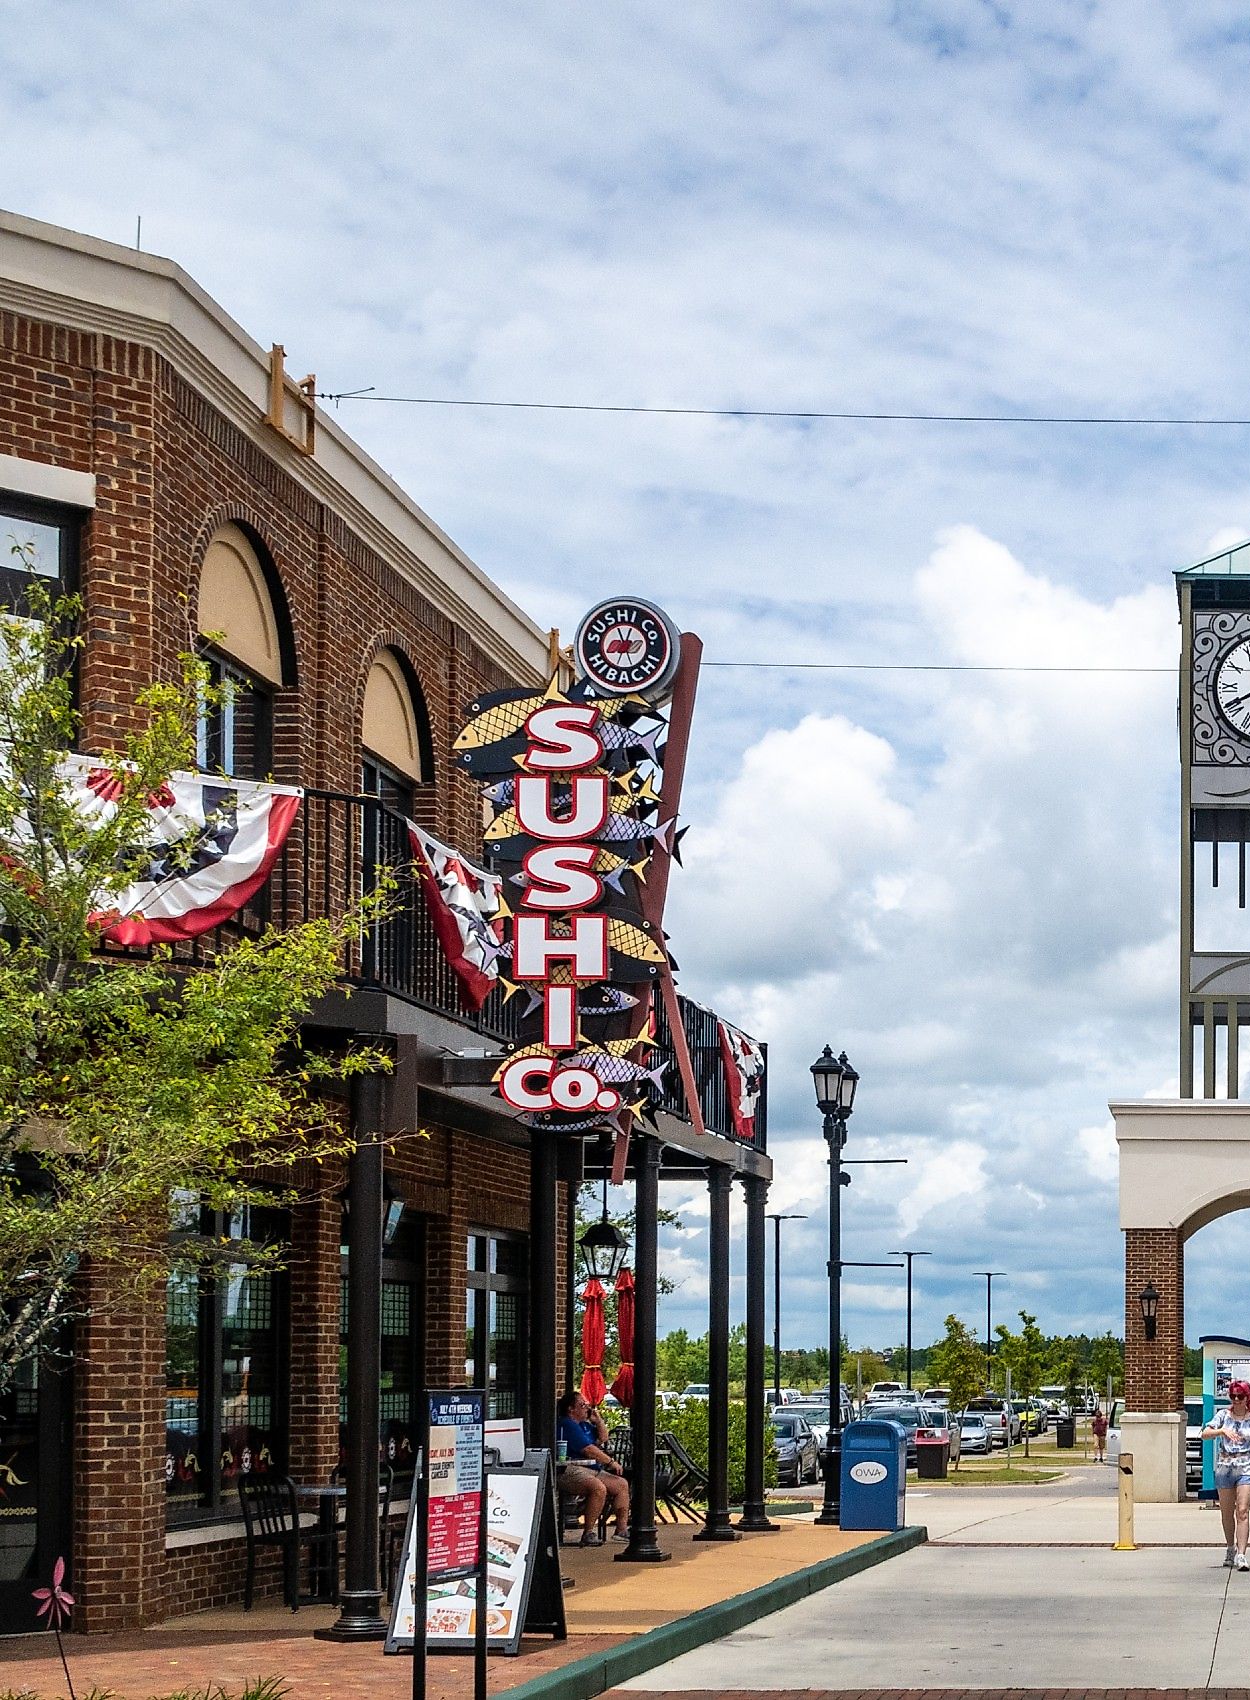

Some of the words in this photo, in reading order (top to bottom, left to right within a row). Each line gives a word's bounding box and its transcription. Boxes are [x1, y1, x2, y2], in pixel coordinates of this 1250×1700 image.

[588, 610, 637, 643] SUSHI
[642, 620, 658, 646] Co.
[589, 654, 660, 684] HIBACHI
[513, 704, 608, 1049] SUSHI
[500, 1057, 621, 1112] Co.
[855, 1468, 882, 1477] OWA
